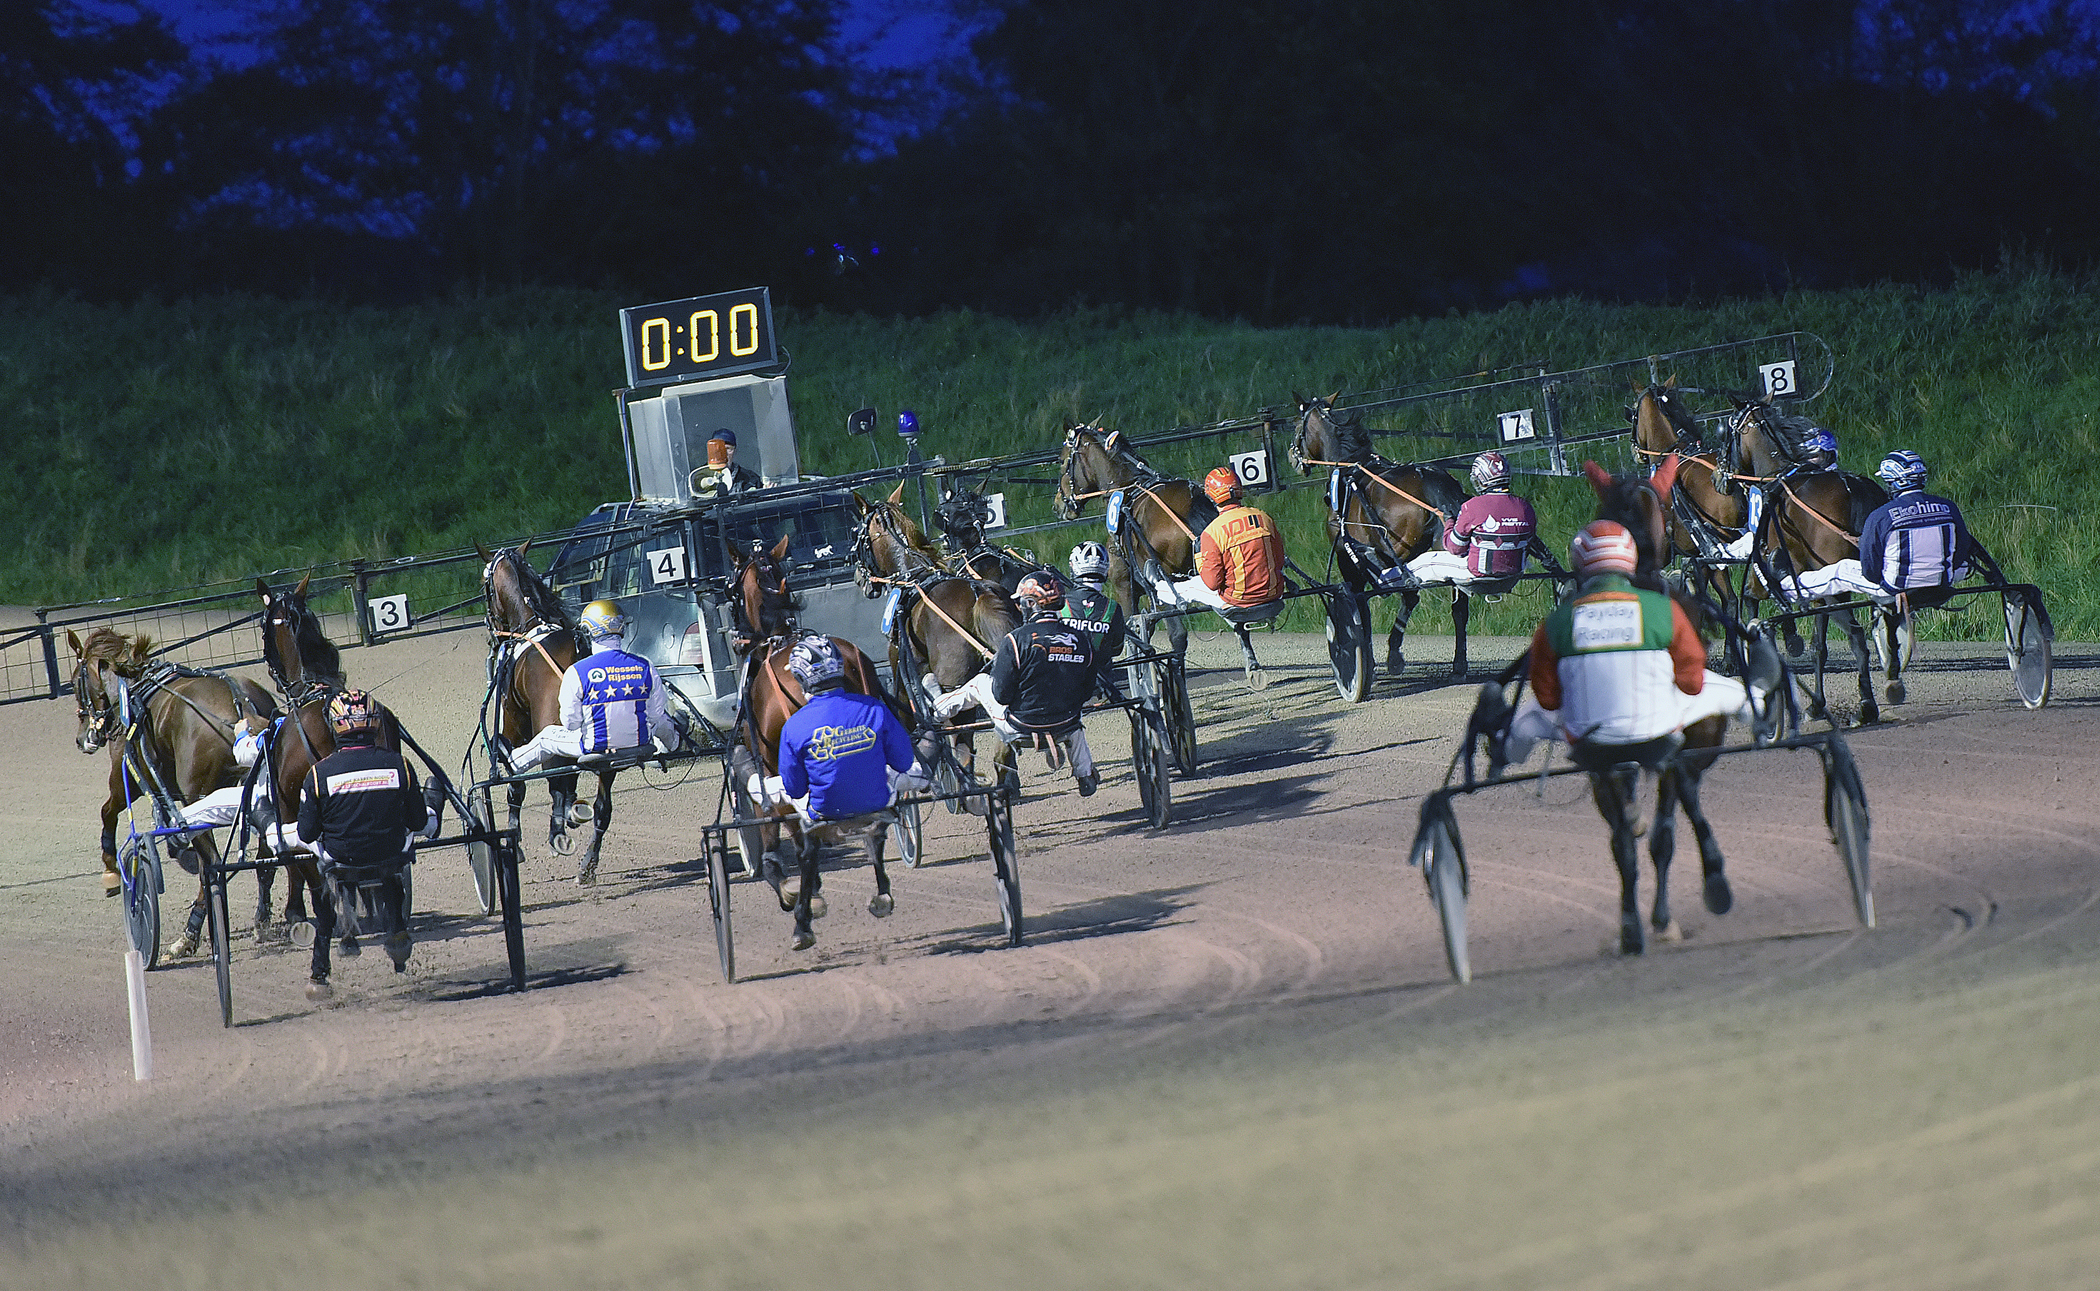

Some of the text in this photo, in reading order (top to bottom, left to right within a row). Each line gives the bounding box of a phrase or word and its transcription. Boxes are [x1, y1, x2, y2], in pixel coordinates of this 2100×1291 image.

[642, 303, 759, 371] 0:00
[1771, 367, 1788, 391] 8
[1509, 414, 1521, 437] 7
[1242, 457, 1260, 481] 6
[658, 553, 677, 577] 4
[381, 601, 400, 627] 3
[1062, 618, 1111, 634] TRIFLOR
[1048, 653, 1085, 663] STABLES
[1049, 646, 1073, 654] BROS
[605, 665, 644, 674] Wessels
[608, 673, 643, 683] Rijssen
